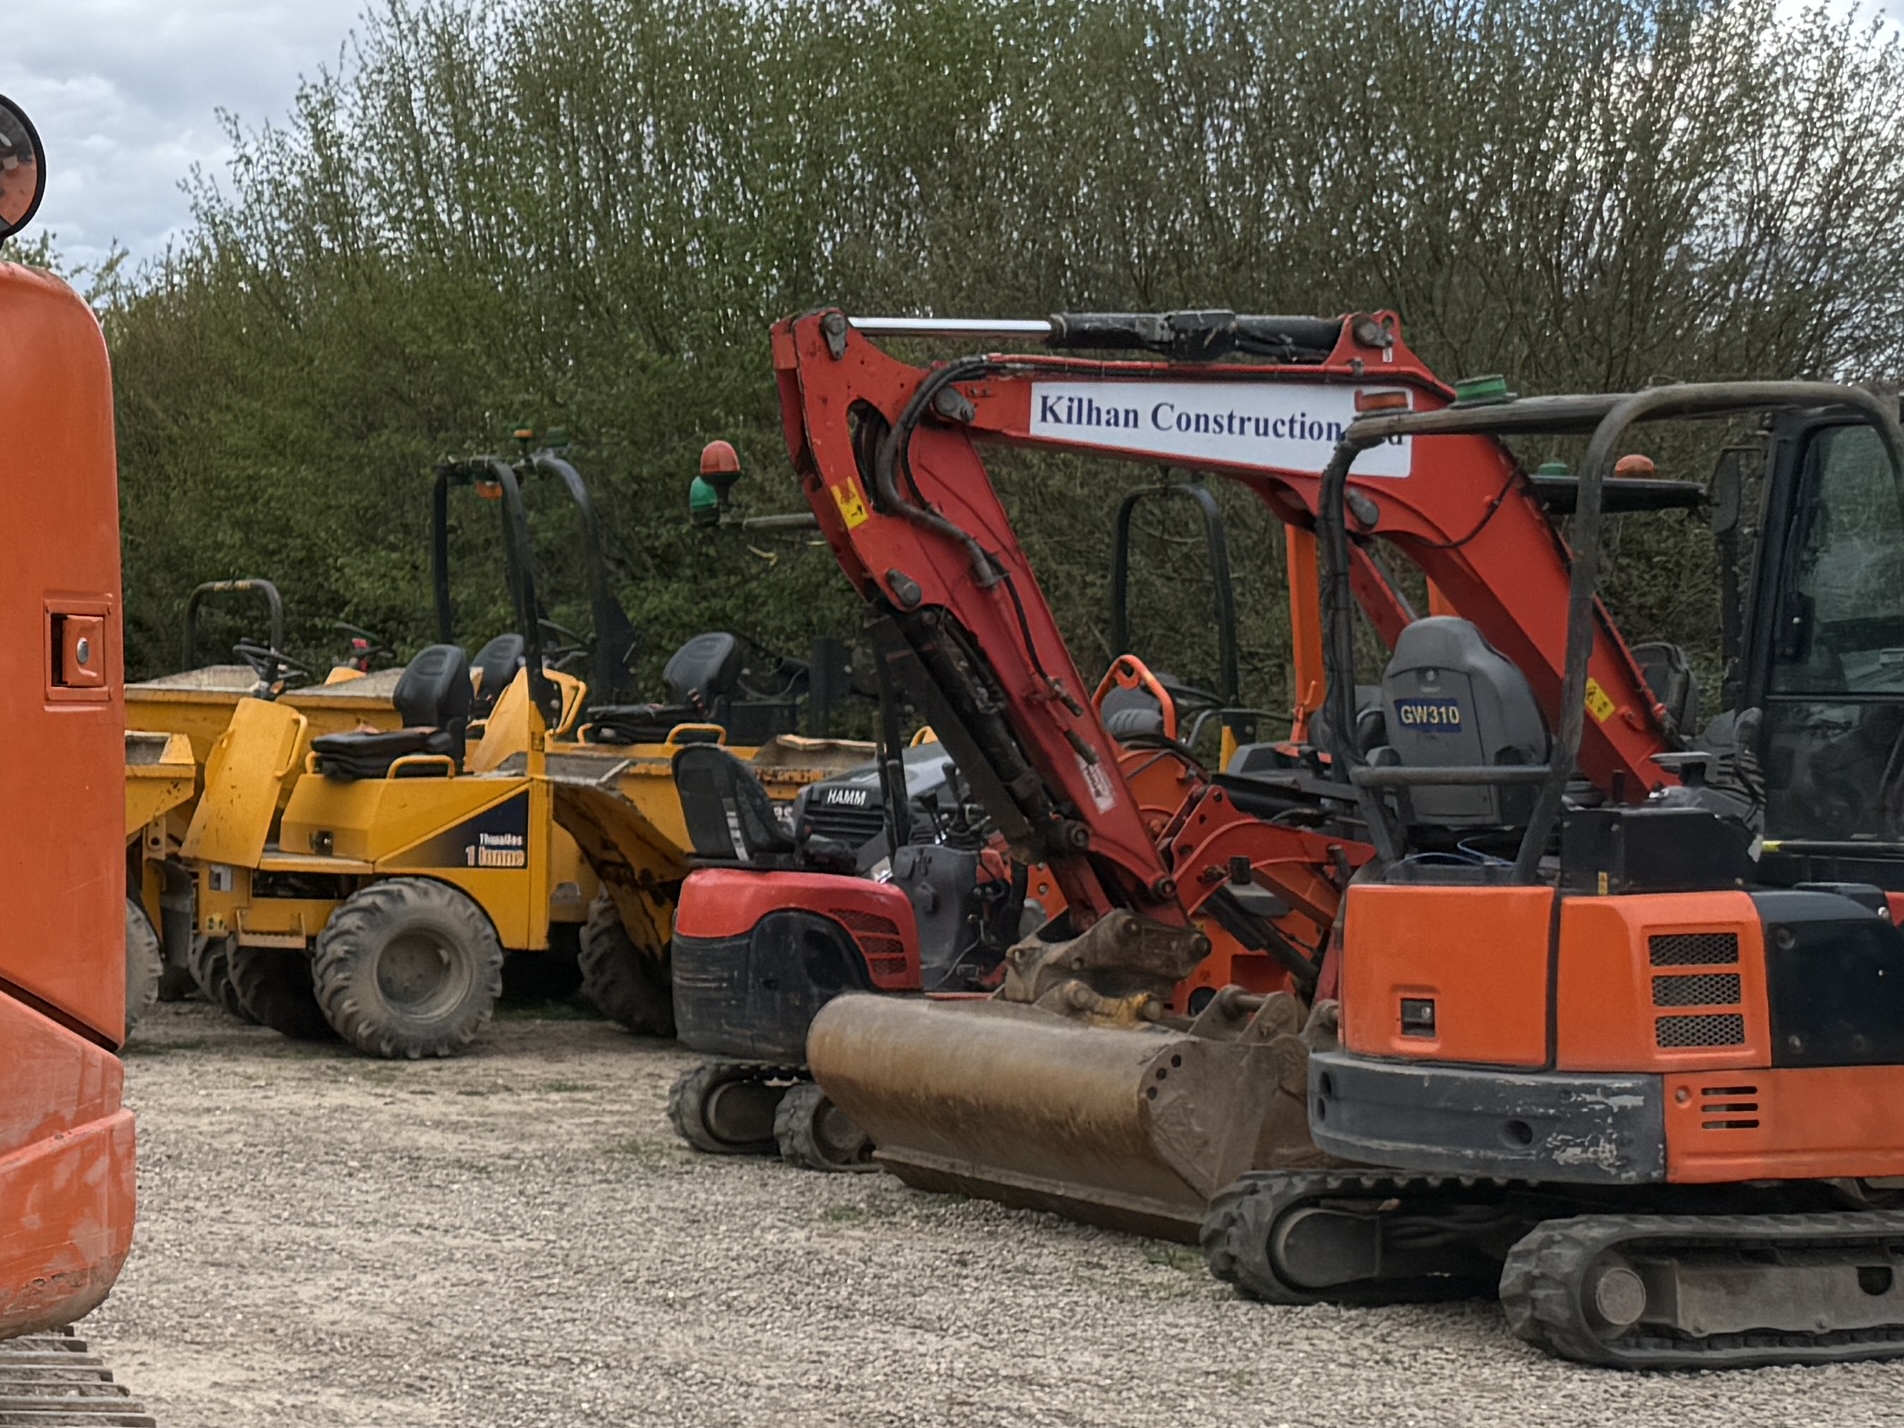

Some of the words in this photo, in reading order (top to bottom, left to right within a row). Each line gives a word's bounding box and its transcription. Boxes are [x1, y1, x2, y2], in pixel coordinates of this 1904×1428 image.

[1040, 395, 1139, 429] Kilhan
[1150, 402, 1345, 442] Construction
[1401, 705, 1460, 724] GW310
[827, 788, 867, 806] HAMM
[466, 845, 475, 866] 1
